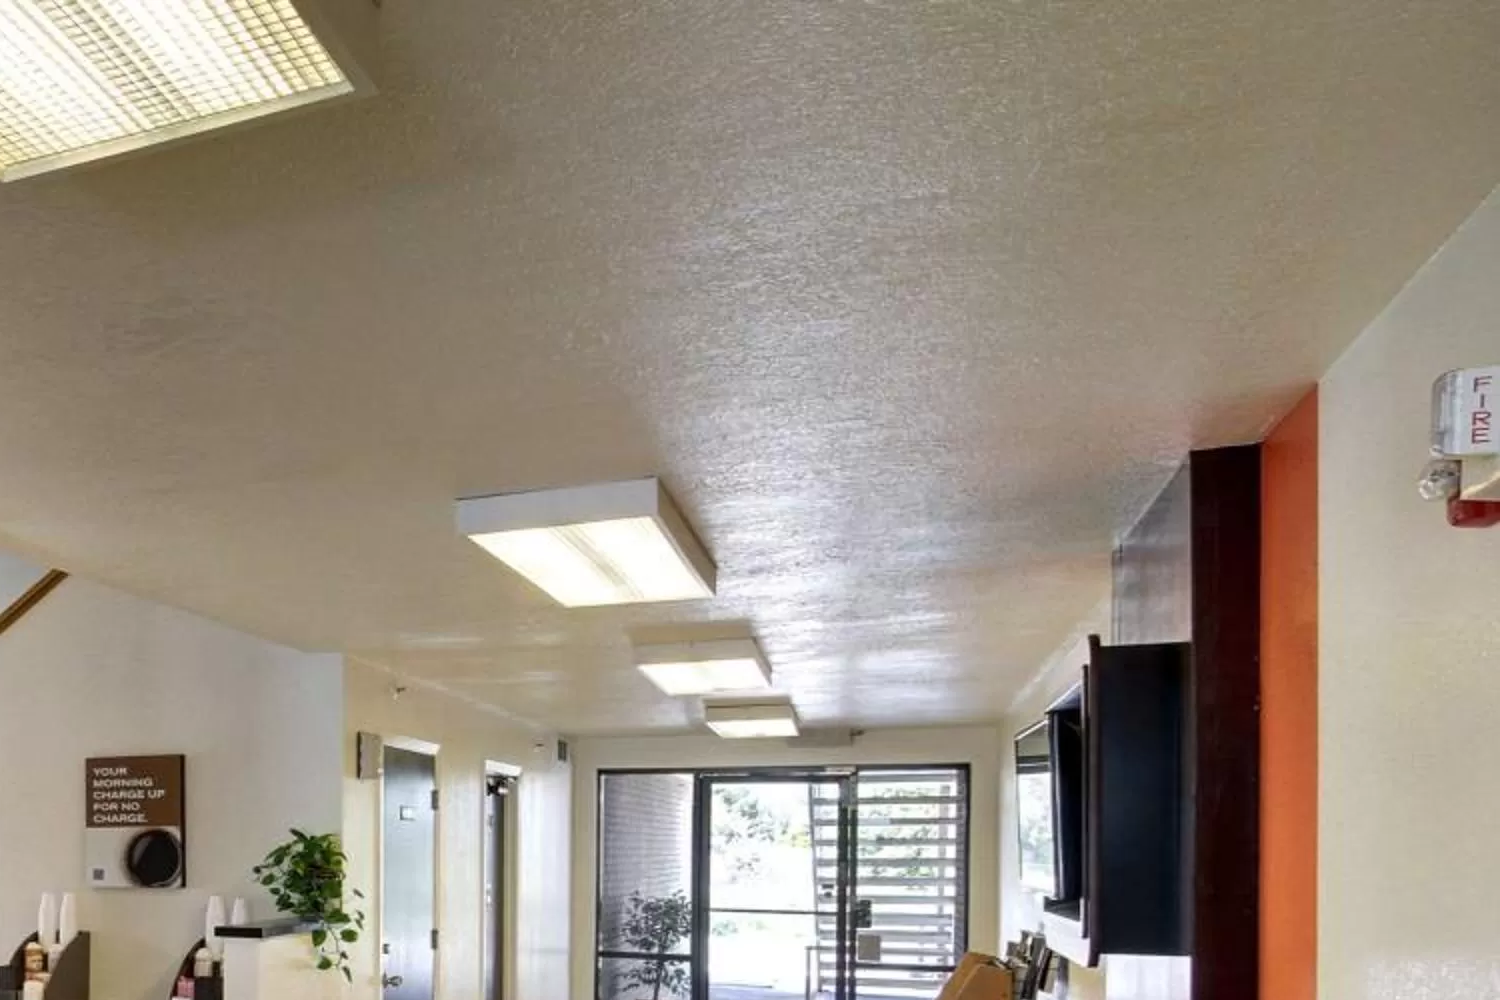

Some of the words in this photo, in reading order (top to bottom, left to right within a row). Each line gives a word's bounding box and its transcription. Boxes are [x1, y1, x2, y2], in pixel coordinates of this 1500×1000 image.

[1471, 376, 1493, 444] FIRE
[93, 767, 127, 777] YOUR
[93, 778, 153, 788] MORNING
[93, 789, 145, 800] CHARGE
[147, 789, 165, 799] UP
[93, 801, 119, 811] FOR
[121, 801, 140, 811] NO
